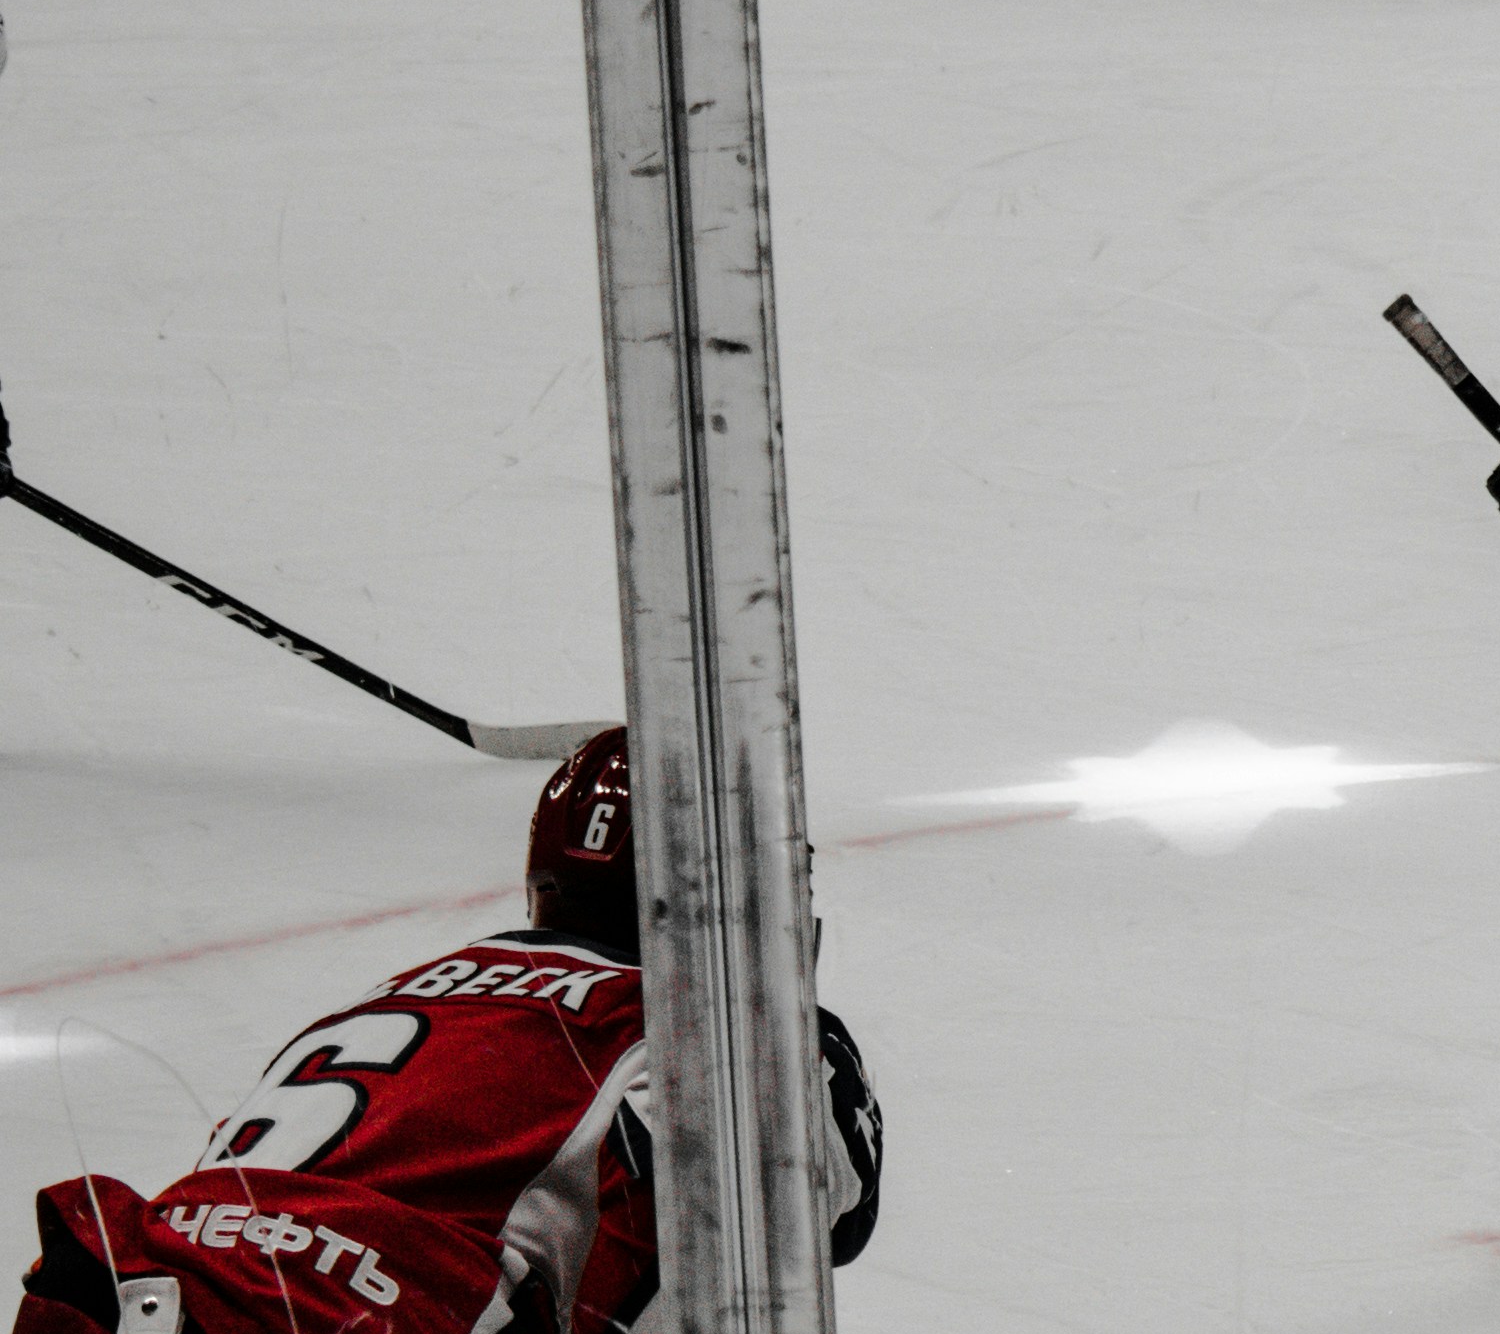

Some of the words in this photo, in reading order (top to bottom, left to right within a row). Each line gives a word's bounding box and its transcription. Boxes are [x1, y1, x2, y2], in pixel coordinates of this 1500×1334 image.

[584, 803, 616, 851] 6
[197, 1010, 430, 1171] 6
[160, 1203, 401, 1307] НЕФТЬ
